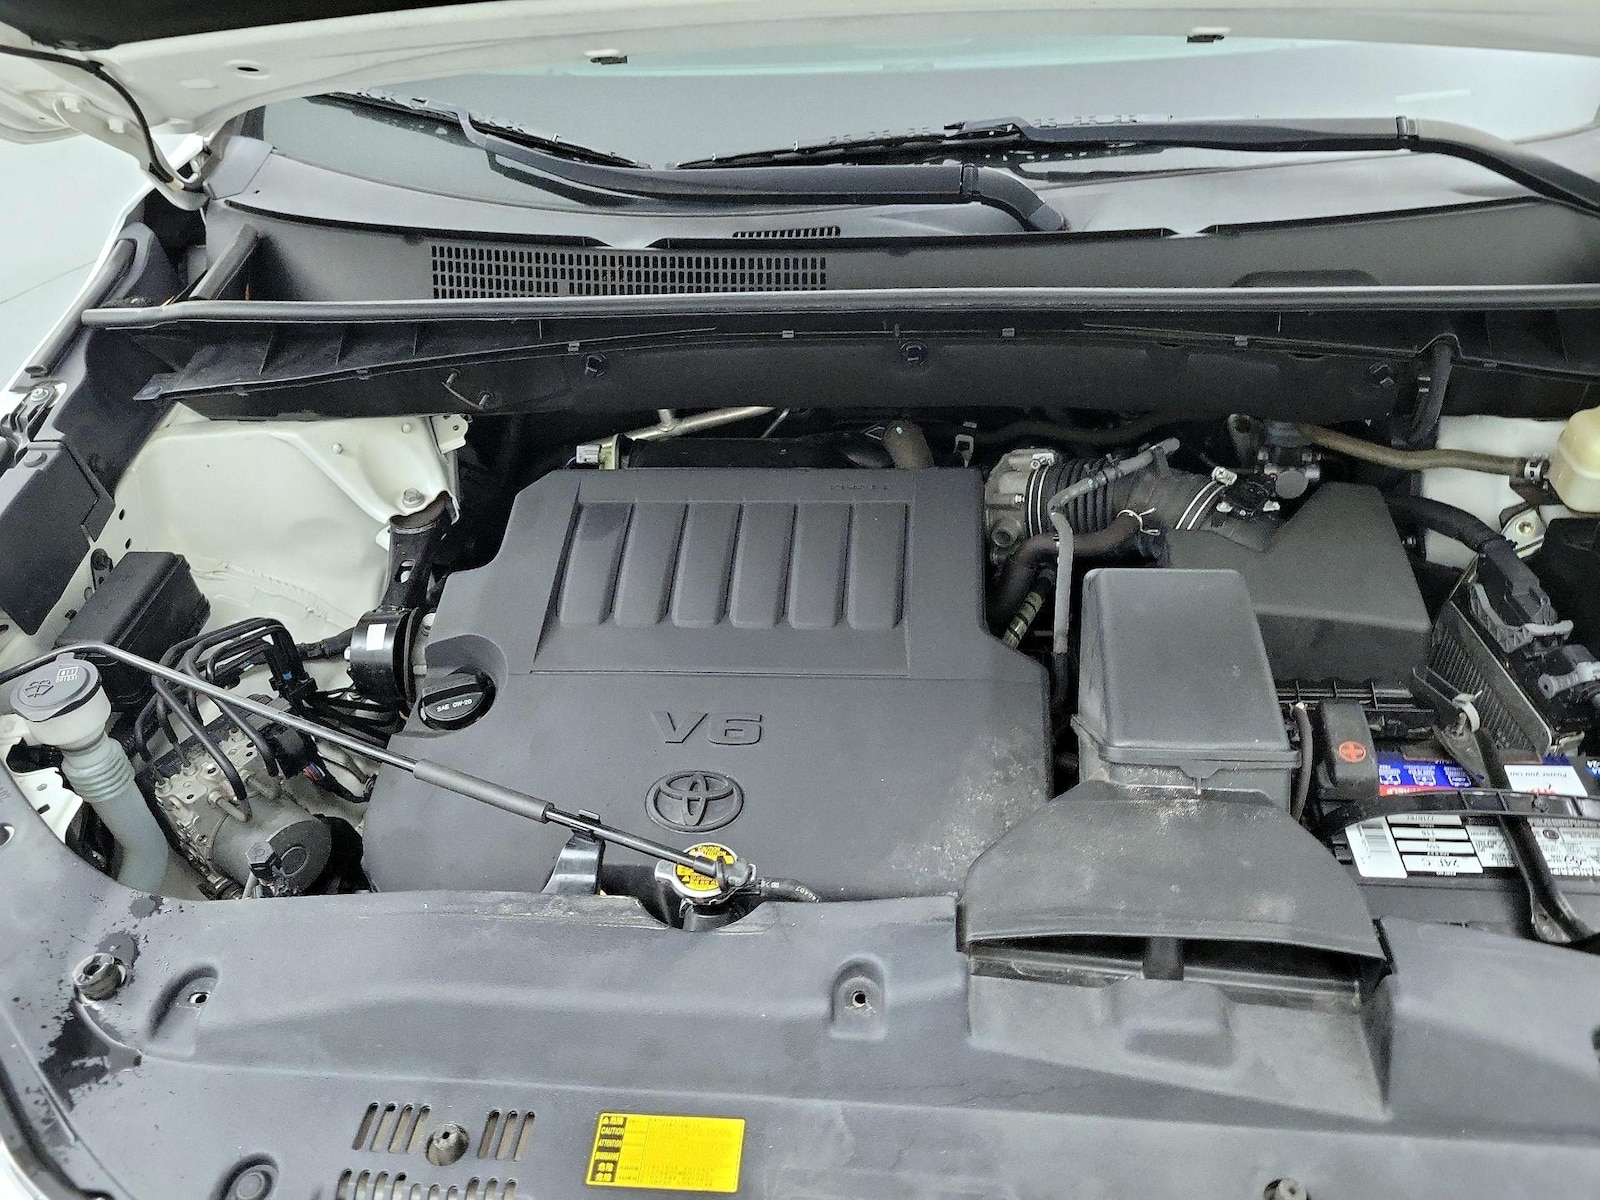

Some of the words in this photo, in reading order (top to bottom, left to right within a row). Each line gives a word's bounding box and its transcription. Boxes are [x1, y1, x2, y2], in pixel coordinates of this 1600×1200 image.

[436, 704, 450, 713] SAE
[452, 698, 473, 709] 0W-20
[649, 710, 763, 746] V6
[600, 1126, 625, 1136] CAUTION
